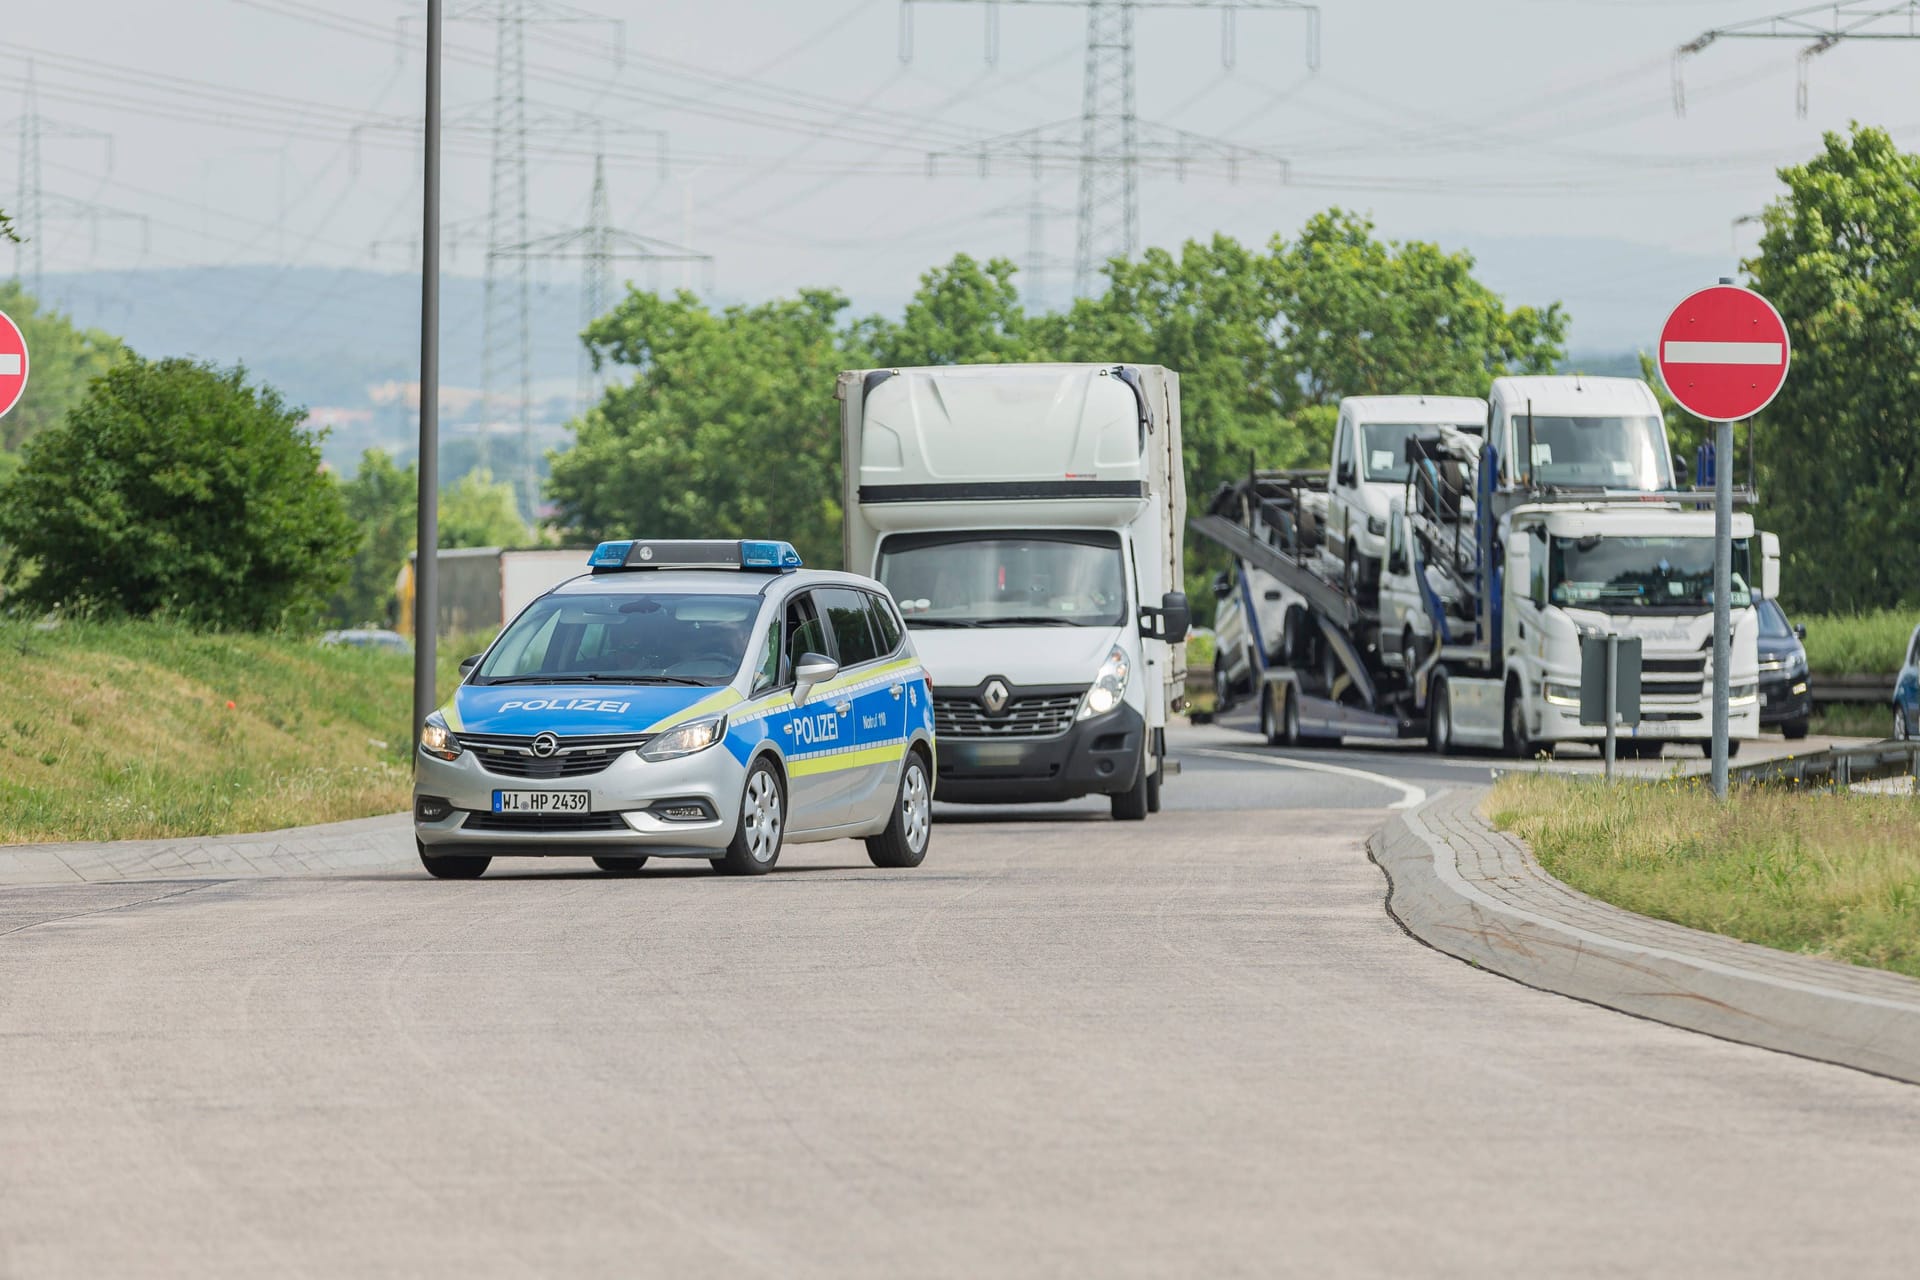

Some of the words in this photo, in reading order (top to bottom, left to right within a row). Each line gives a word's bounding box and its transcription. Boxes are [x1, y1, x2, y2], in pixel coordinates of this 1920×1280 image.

[498, 699, 631, 713] POLIZEI
[793, 712, 838, 745] POLIZEI
[503, 794, 519, 809] WI
[530, 794, 548, 809] HP
[552, 794, 586, 809] 2439
